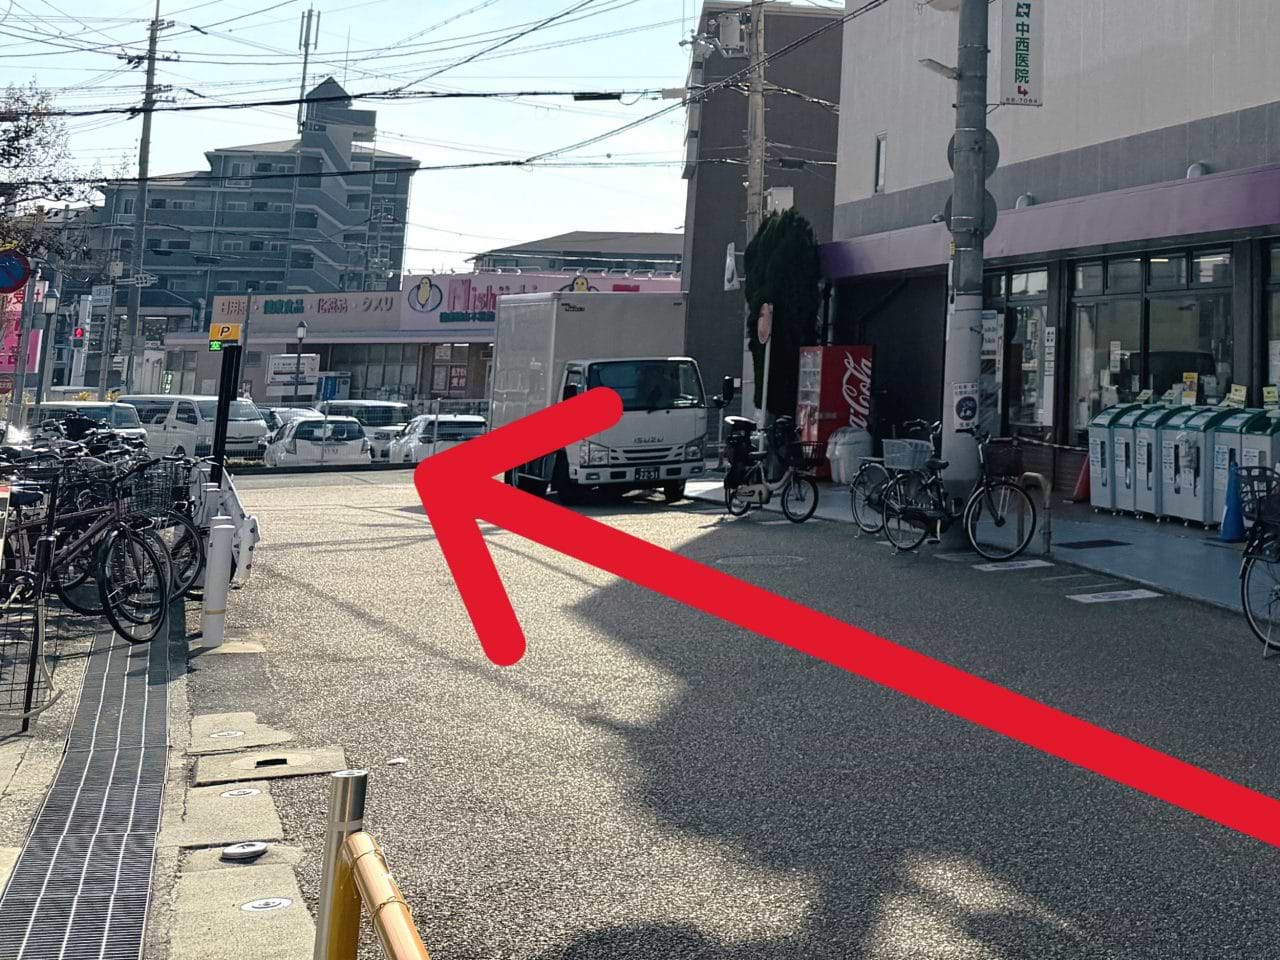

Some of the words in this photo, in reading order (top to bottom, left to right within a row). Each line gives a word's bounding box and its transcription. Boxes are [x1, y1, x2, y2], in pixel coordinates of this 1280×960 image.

[1014, 21, 1030, 84] 中西医院
[219, 326, 231, 337] P
[633, 436, 664, 444] ISUZU
